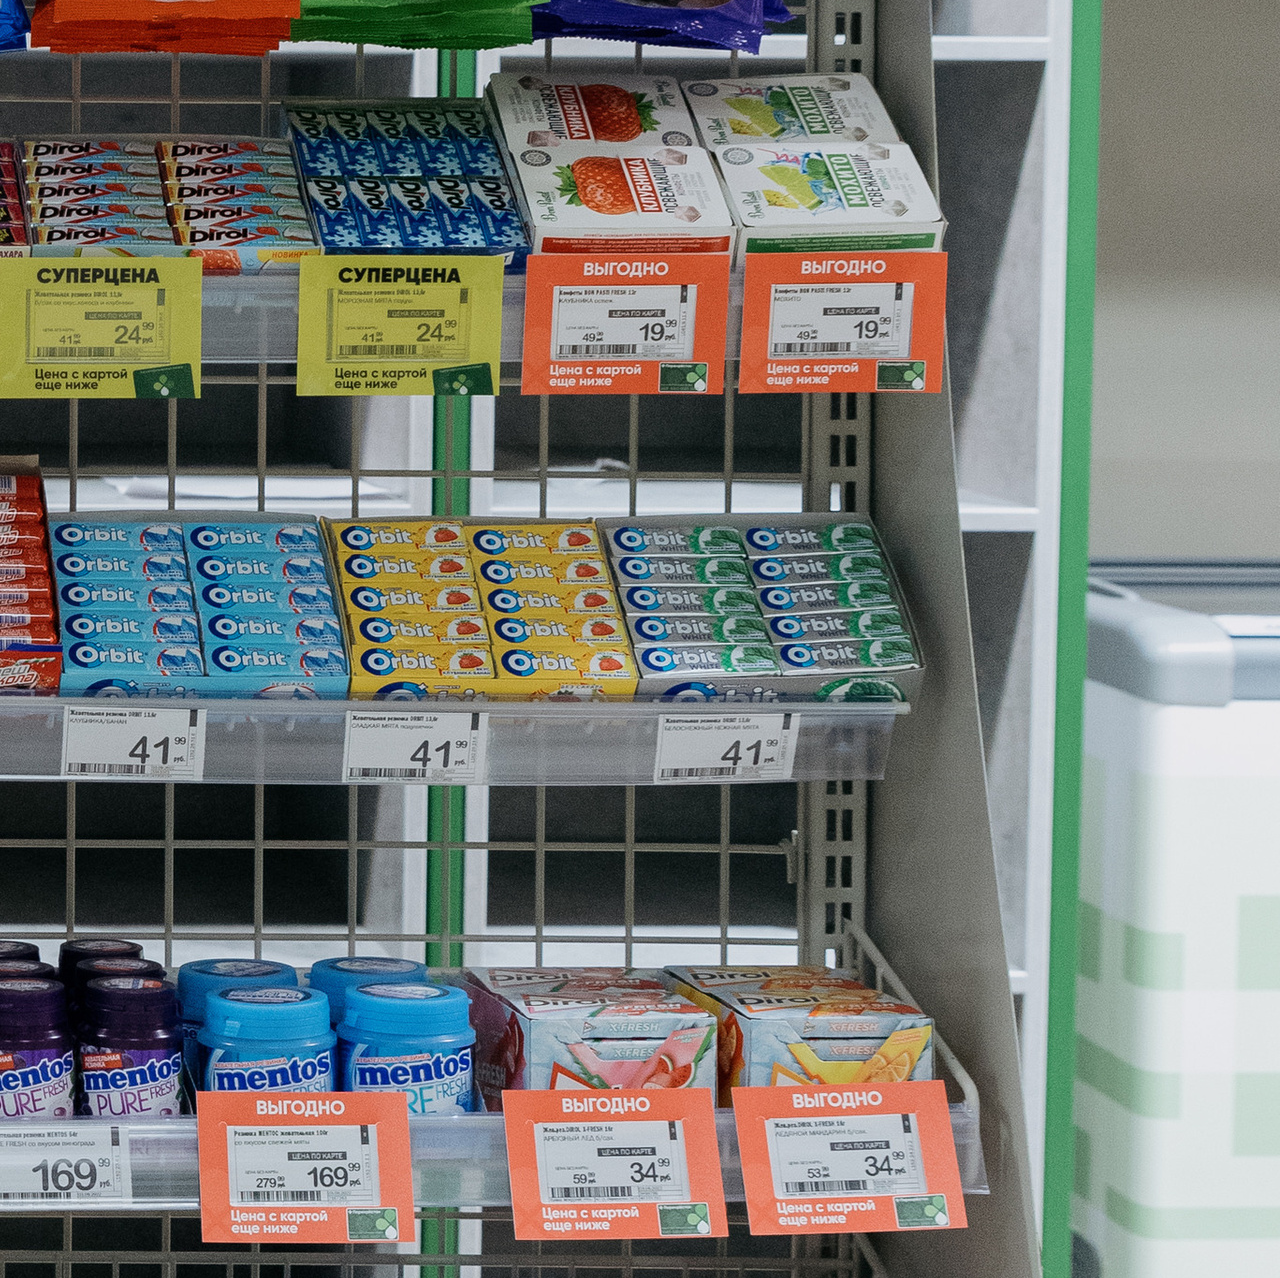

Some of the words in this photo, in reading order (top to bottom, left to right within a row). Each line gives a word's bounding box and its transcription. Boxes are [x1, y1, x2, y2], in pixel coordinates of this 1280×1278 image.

[623, 157, 653, 213] КЛУБНИКА
[836, 154, 859, 207] МОХИТО
[46, 227, 107, 243] Dirol
[36, 267, 160, 286] СУПЕРЦЕНА
[338, 267, 461, 286] СУПЕРЦЕНА
[582, 261, 669, 279] ВЫГОДНО
[800, 259, 887, 277] ВЫГОДНО
[639, 321, 665, 342] 19
[853, 320, 879, 340] 19
[65, 524, 127, 545] Orbit
[364, 649, 436, 673] Orbit
[647, 646, 718, 669] Orbit
[128, 735, 169, 765] 41
[410, 739, 450, 769] 41
[721, 739, 762, 766] 41
[84, 1050, 181, 1092] mentos
[255, 1097, 346, 1117] ВЫГОДНО
[562, 1096, 650, 1114] ВЫГОДНО
[793, 1089, 883, 1110] ВЫГОДНО
[31, 1158, 97, 1191] 169
[629, 1162, 658, 1184] 34
[864, 1156, 892, 1178] 34
